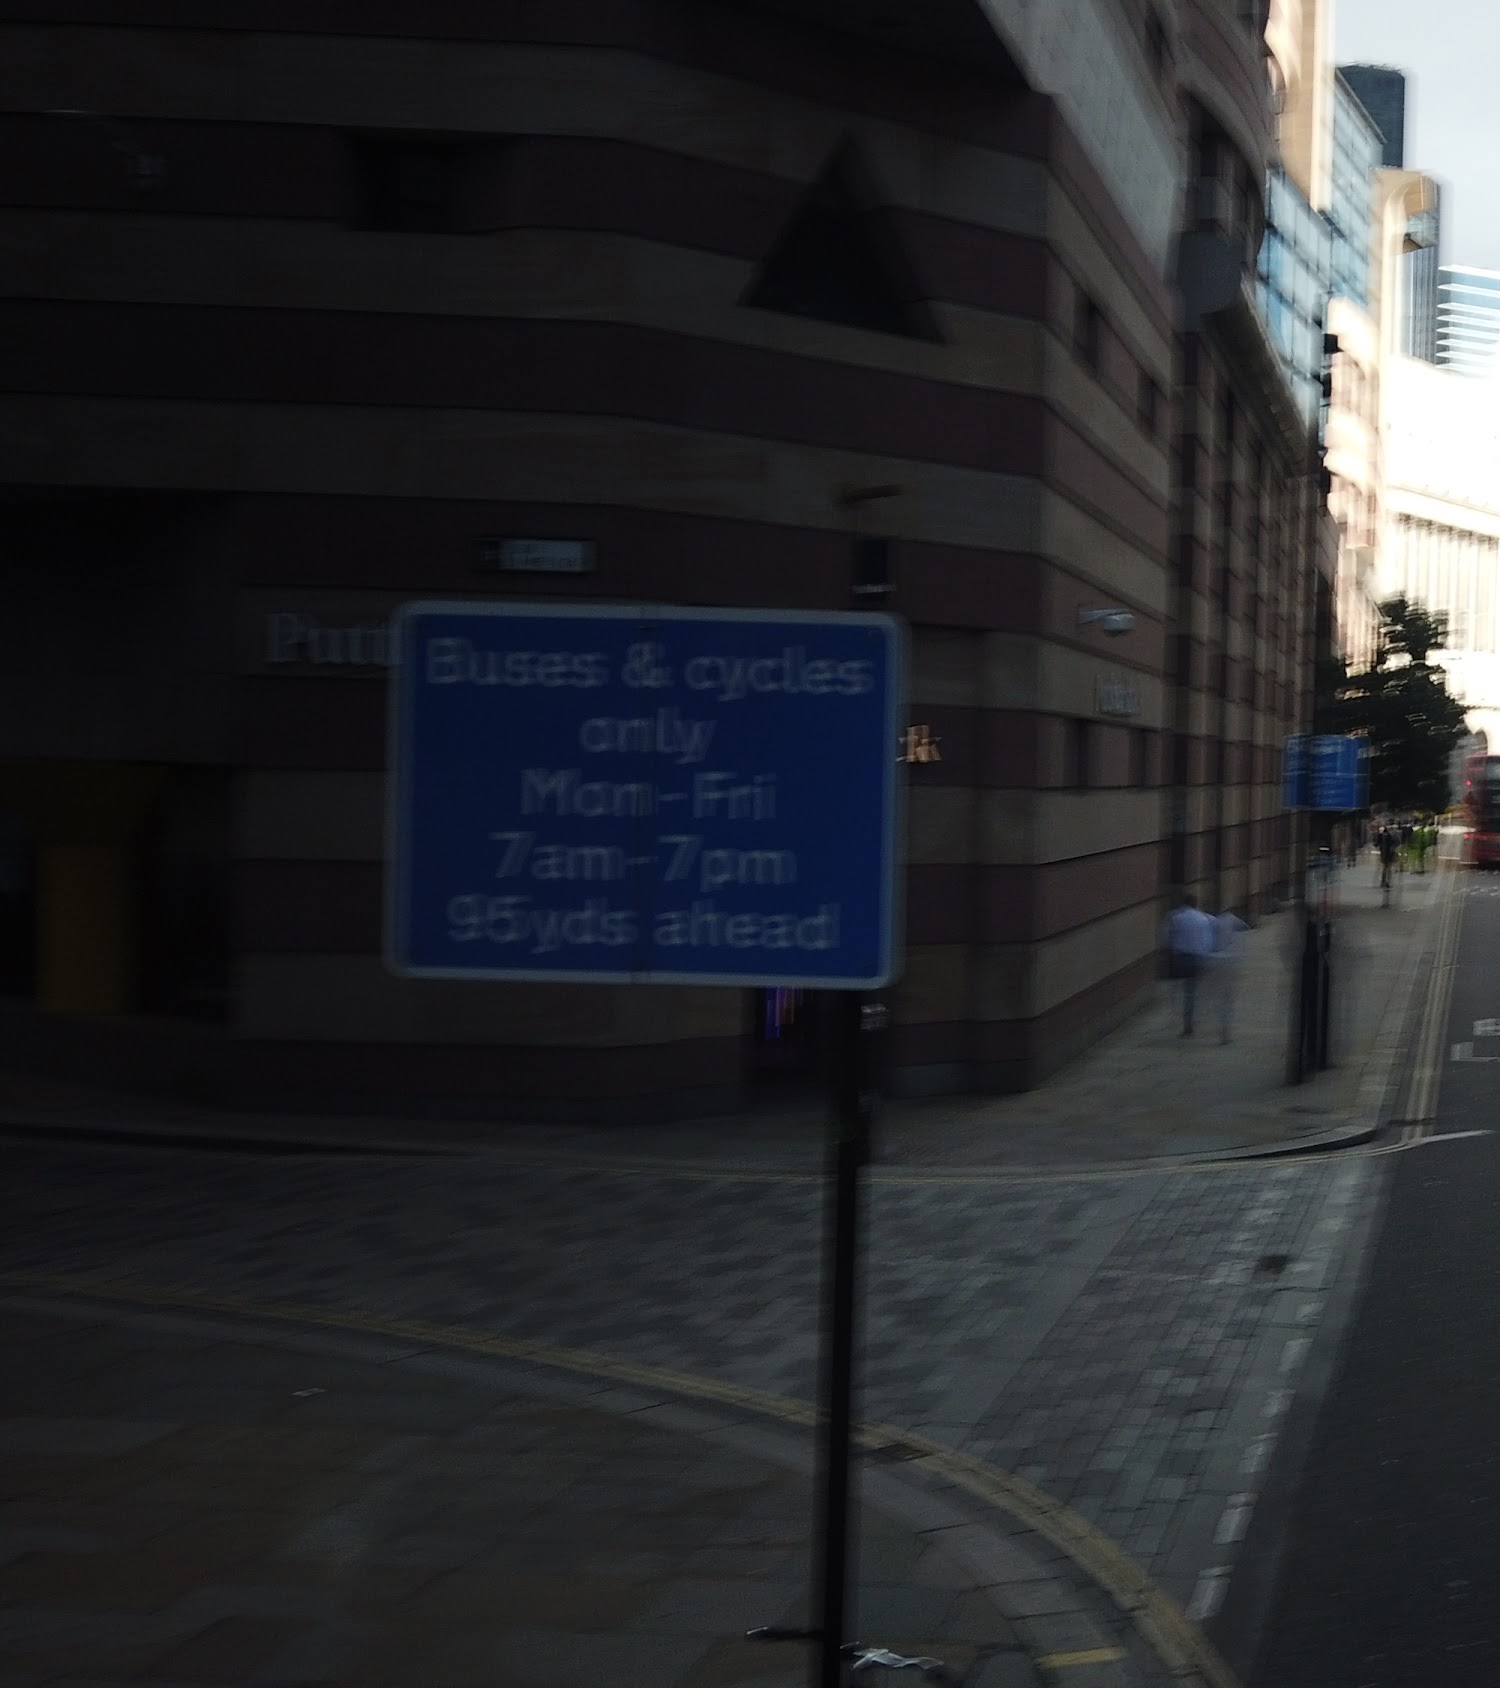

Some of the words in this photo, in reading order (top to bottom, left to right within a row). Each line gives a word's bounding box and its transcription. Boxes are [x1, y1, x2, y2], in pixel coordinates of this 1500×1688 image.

[426, 637, 609, 688] Buses
[621, 642, 671, 689] &
[684, 647, 874, 702] cycles
[579, 706, 718, 765] only
[652, 900, 841, 951] ahead
